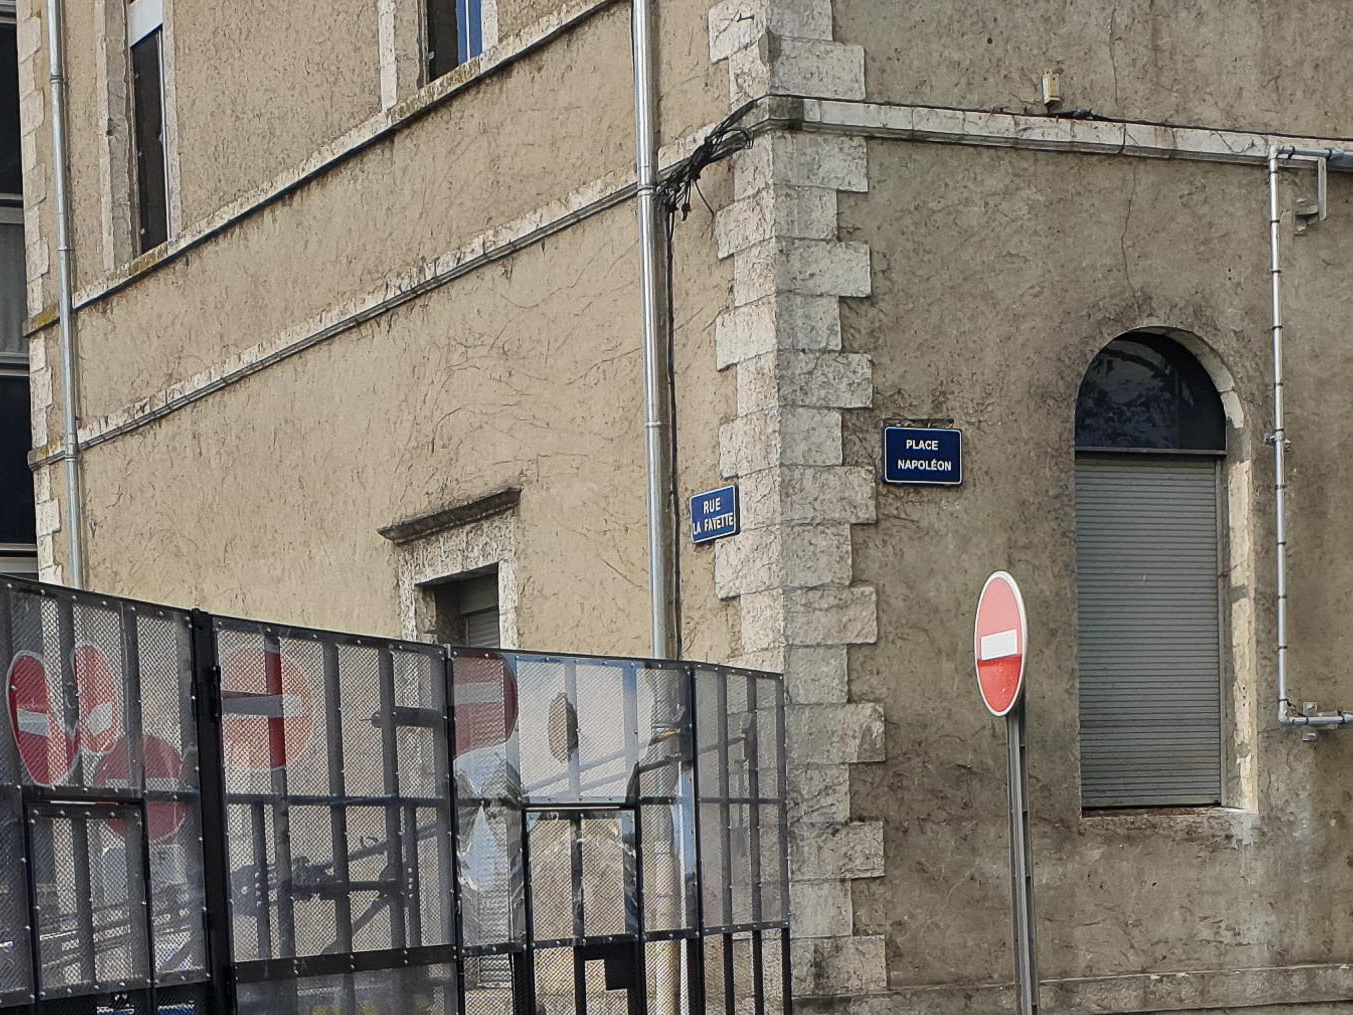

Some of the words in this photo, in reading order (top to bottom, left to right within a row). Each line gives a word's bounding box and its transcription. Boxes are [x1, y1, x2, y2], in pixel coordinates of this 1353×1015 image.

[906, 440, 939, 451] PLACE
[898, 458, 952, 471] NAPOLÉON
[703, 497, 722, 515] RUE
[693, 521, 702, 535] LA
[704, 512, 734, 532] FAYETTE
